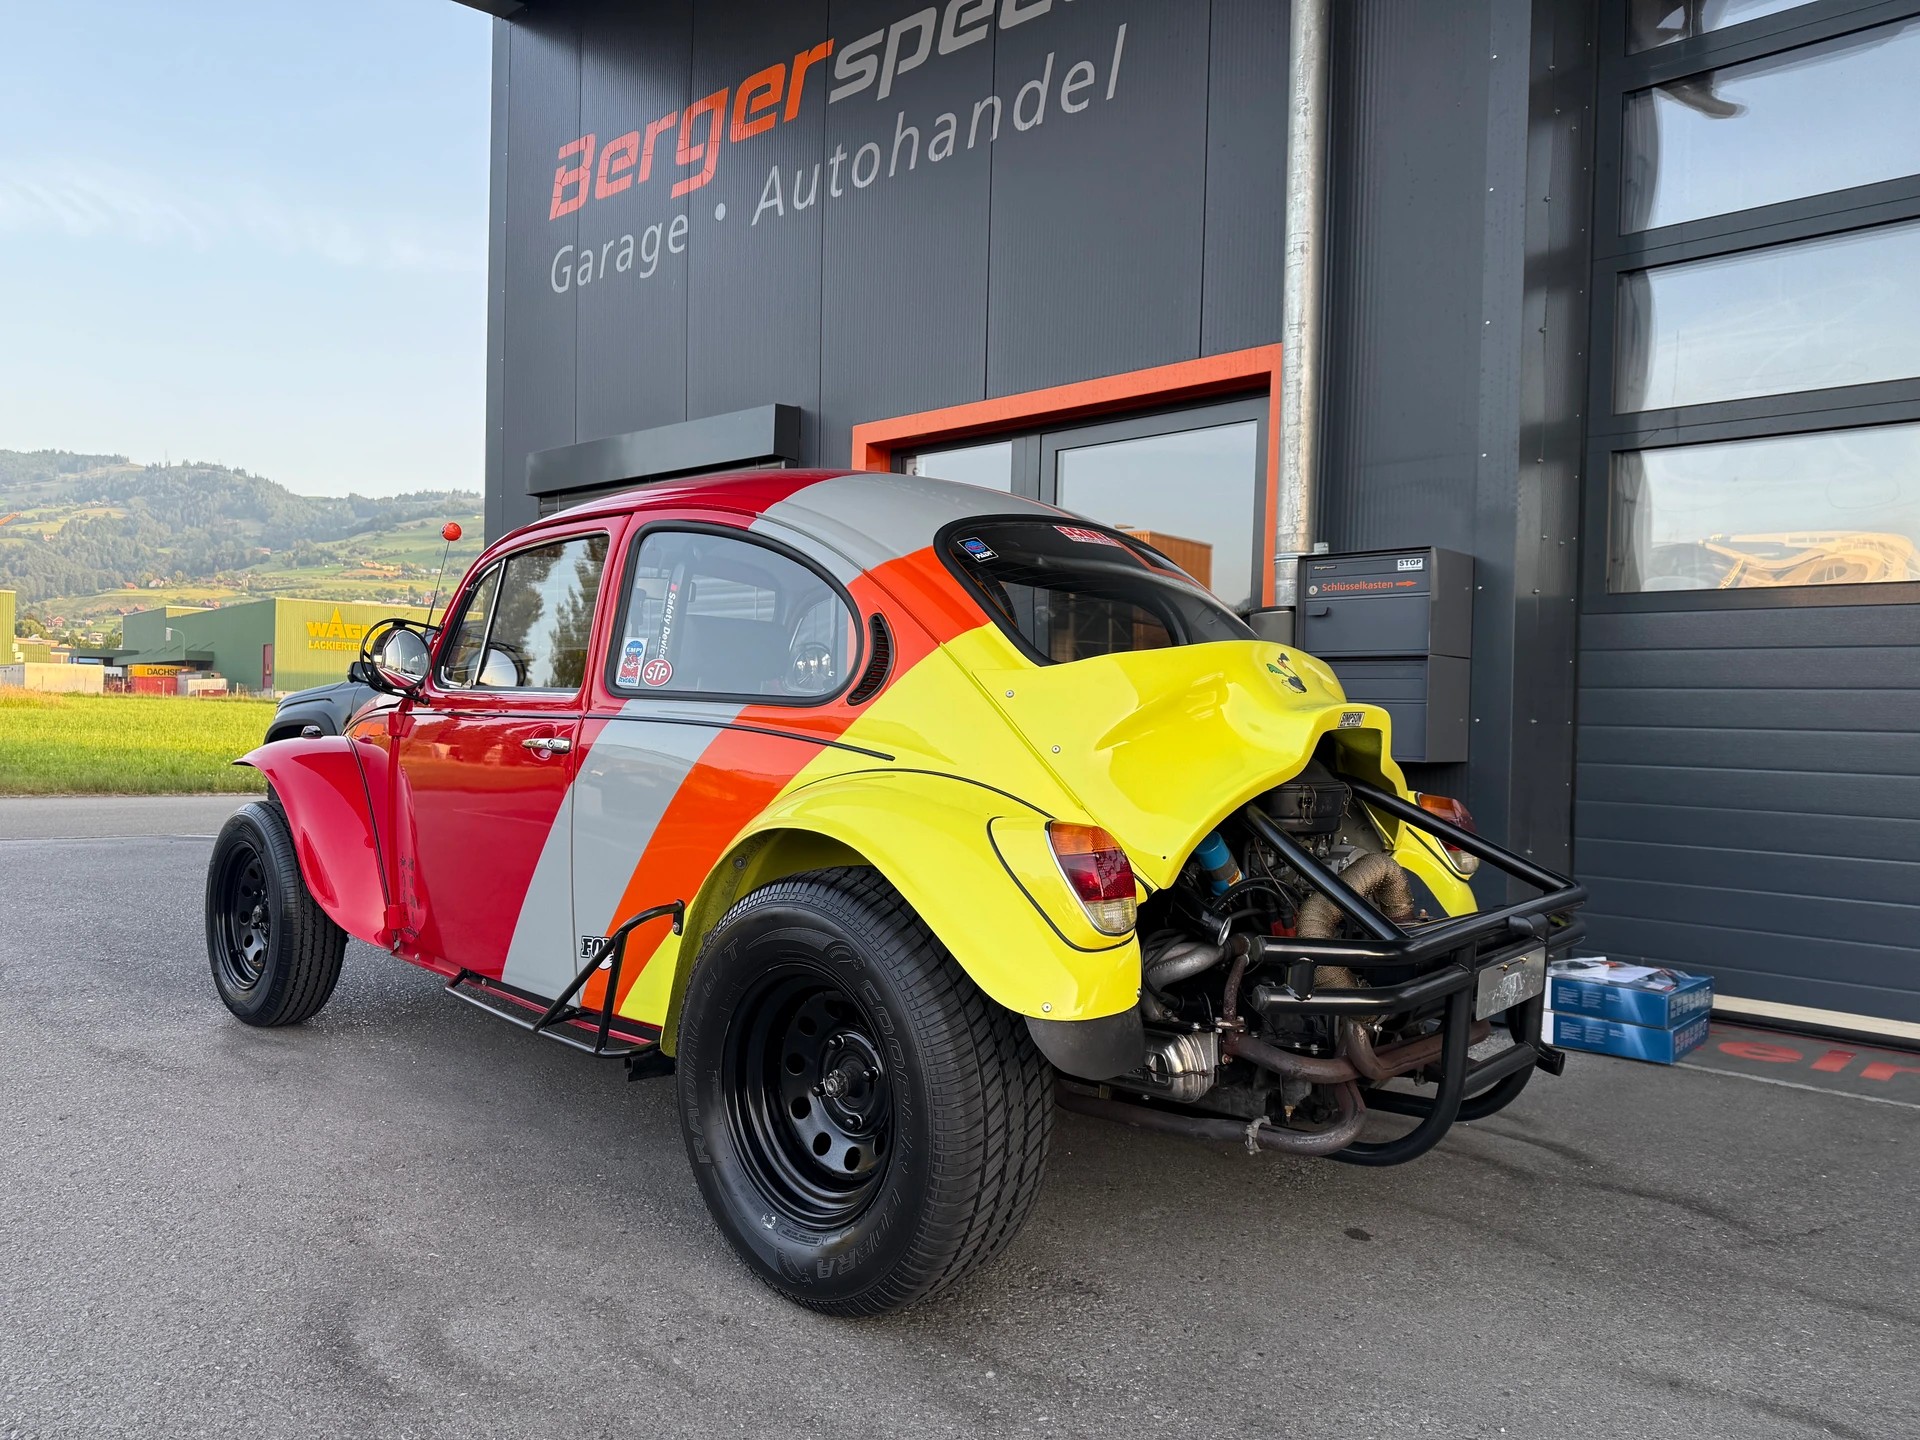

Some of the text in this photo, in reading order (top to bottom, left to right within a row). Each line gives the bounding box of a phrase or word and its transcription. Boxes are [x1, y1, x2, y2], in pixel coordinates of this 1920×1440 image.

[551, 23, 1128, 293] Garage Autohandel
[1399, 559, 1422, 567] STOP
[1322, 581, 1394, 592] Schlüsselkasten
[663, 591, 676, 625] Safety
[645, 662, 668, 681] STP
